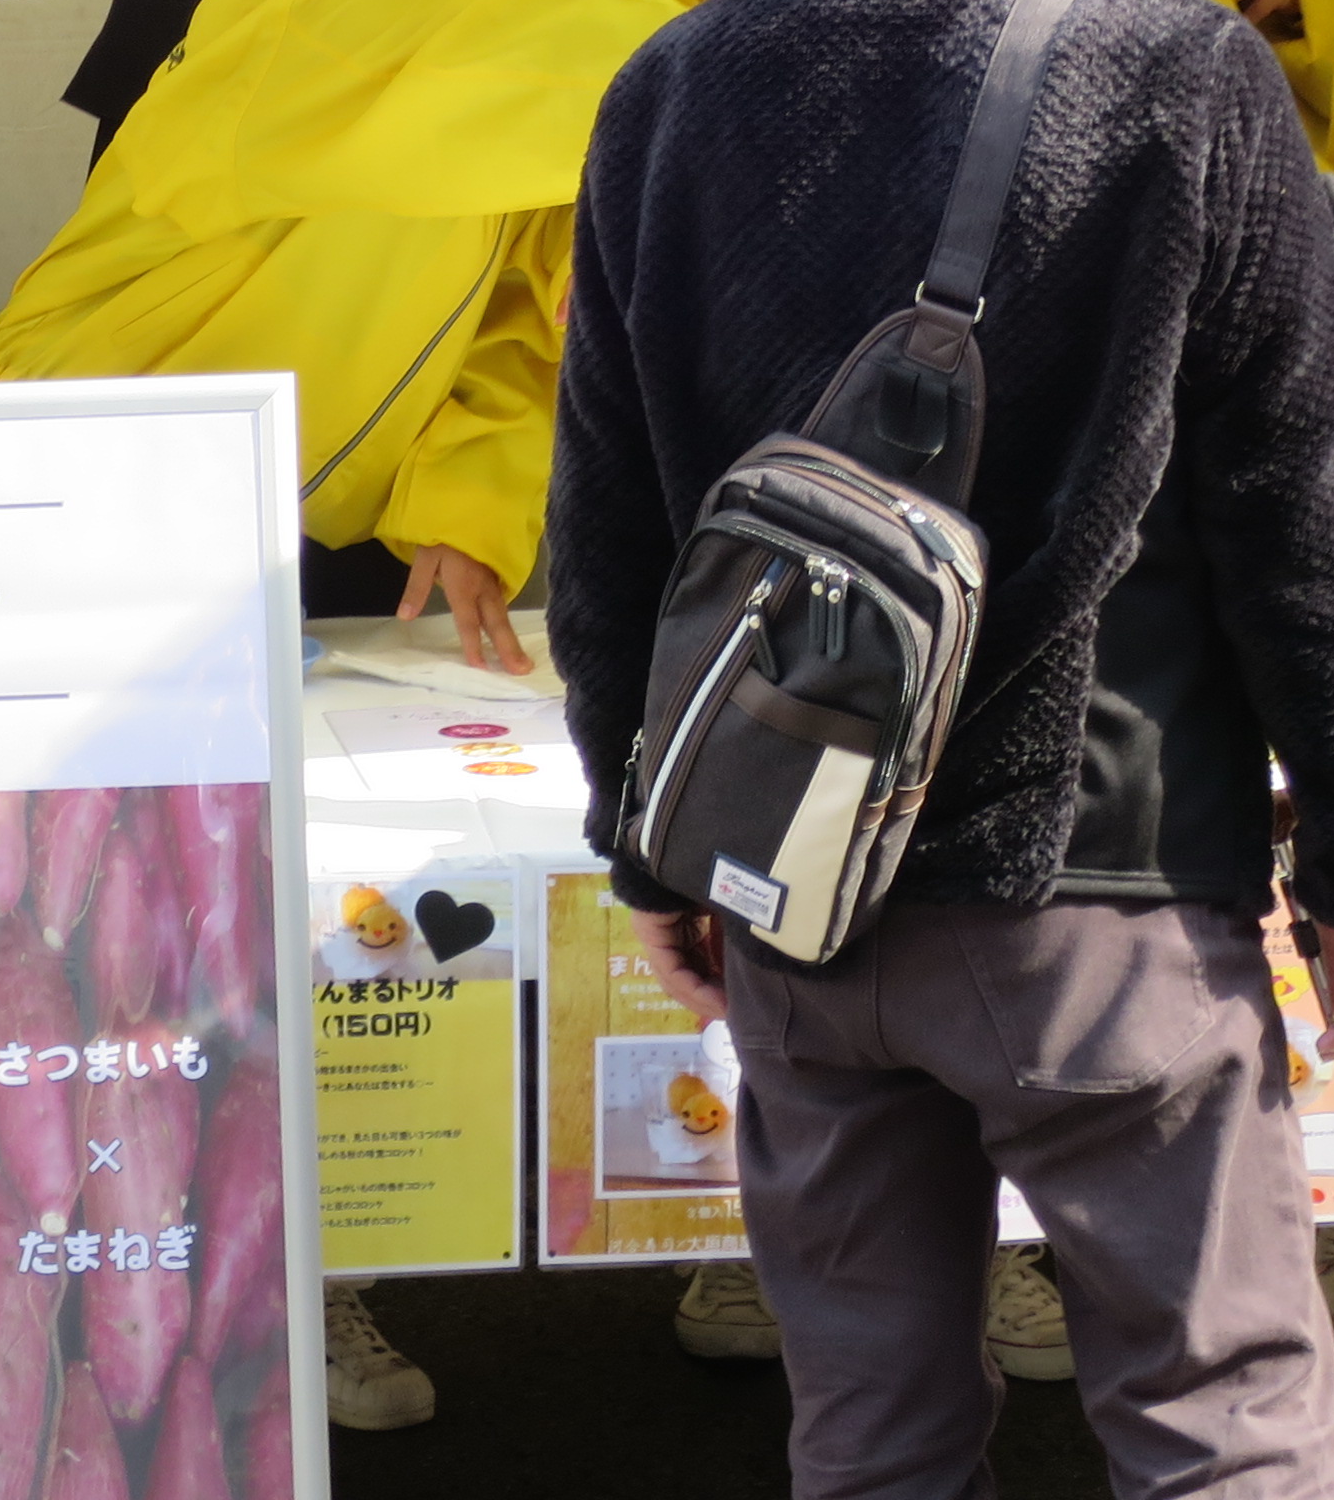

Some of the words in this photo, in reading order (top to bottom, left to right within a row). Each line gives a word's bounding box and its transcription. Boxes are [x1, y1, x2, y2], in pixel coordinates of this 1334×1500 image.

[322, 1011, 432, 1038] (150円)
[17, 1224, 198, 1273] たまねぎ
